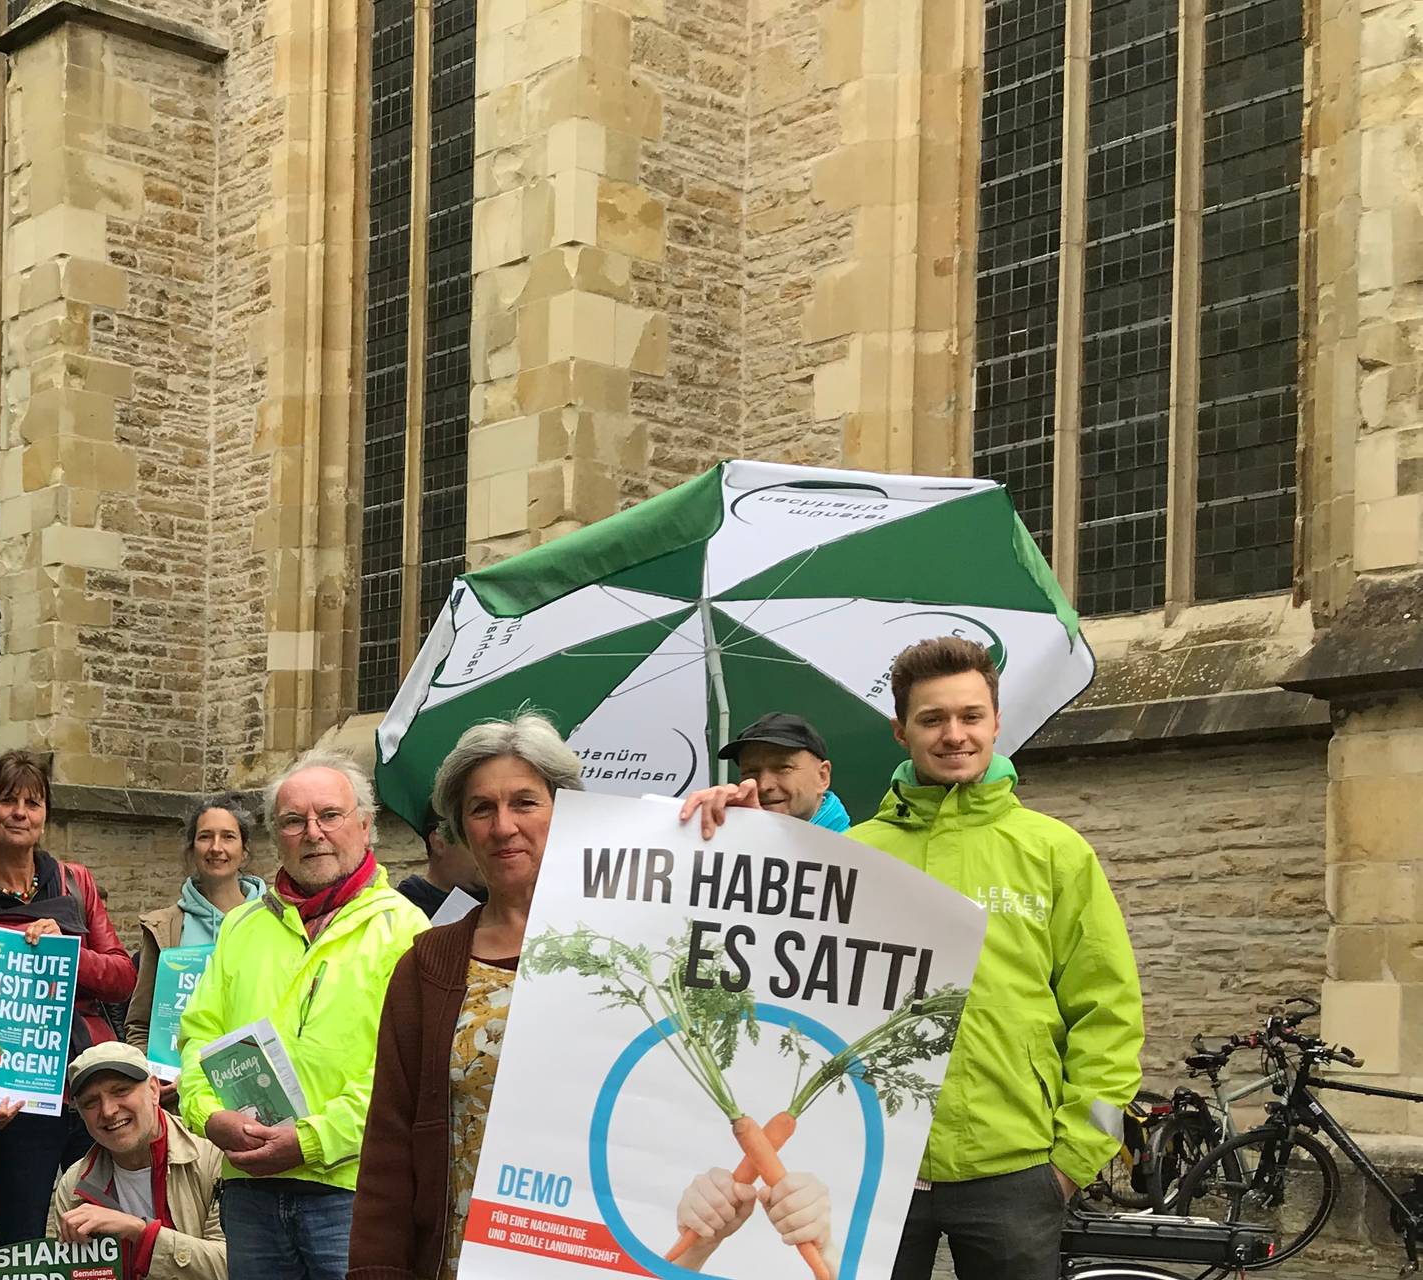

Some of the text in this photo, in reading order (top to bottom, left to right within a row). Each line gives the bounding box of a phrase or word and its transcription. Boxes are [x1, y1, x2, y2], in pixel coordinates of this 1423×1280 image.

[582, 848, 859, 924] WIR HABEN
[7, 951, 71, 977] HEUTE
[684, 920, 934, 1014] ES SATT!
[35, 979, 68, 1001] DIE
[21, 1025, 62, 1051] FÜR
[497, 1164, 573, 1208] DEMO
[491, 1210, 588, 1241] FÜR EINE NACHHALTIGE
[488, 1228, 621, 1264] UND SOZIALE LANDWIRTSCHAFT
